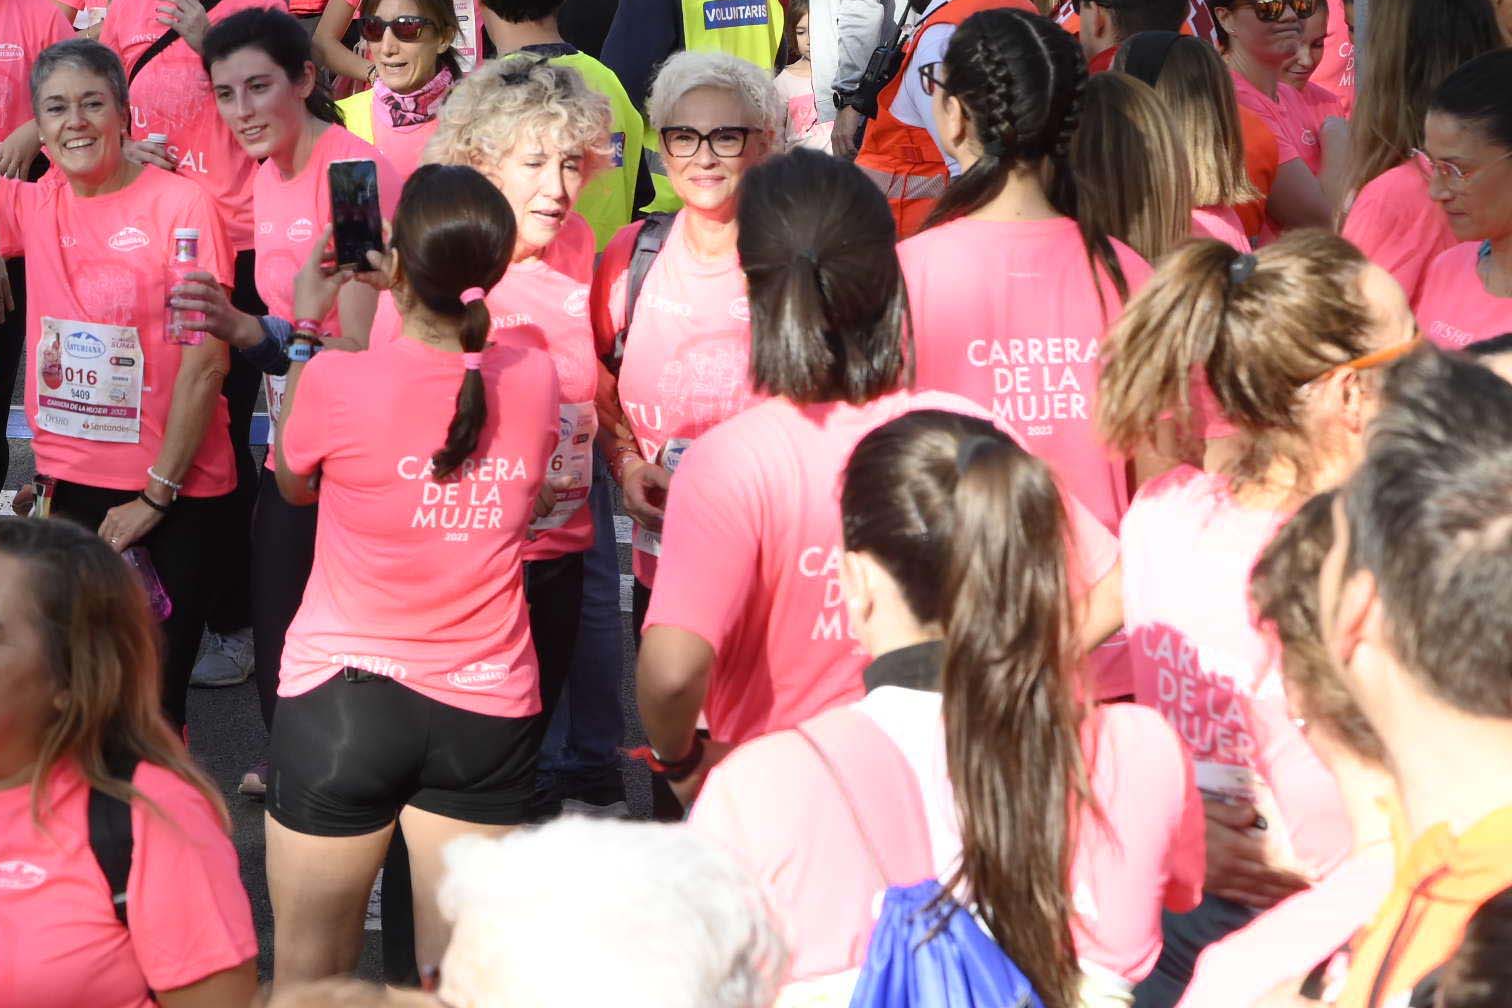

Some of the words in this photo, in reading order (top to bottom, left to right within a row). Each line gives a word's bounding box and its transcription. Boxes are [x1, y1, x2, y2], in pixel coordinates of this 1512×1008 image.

[705, 3, 767, 22] VOLUNTARIS
[967, 336, 1101, 367] CARRERA
[65, 367, 97, 385] 016
[993, 367, 1031, 392] DE
[1043, 363, 1082, 392] LA
[624, 400, 663, 432] TU
[990, 394, 1088, 423] MUJER
[1027, 425, 1054, 436] 2023
[396, 455, 529, 484] CARERA
[422, 482, 459, 506] DE
[467, 481, 502, 506] LA
[411, 507, 505, 531] MUJER
[444, 532, 469, 542] 2023
[329, 653, 407, 680] OYSHO
[1158, 667, 1197, 713] DE
[1207, 687, 1246, 729] LA
